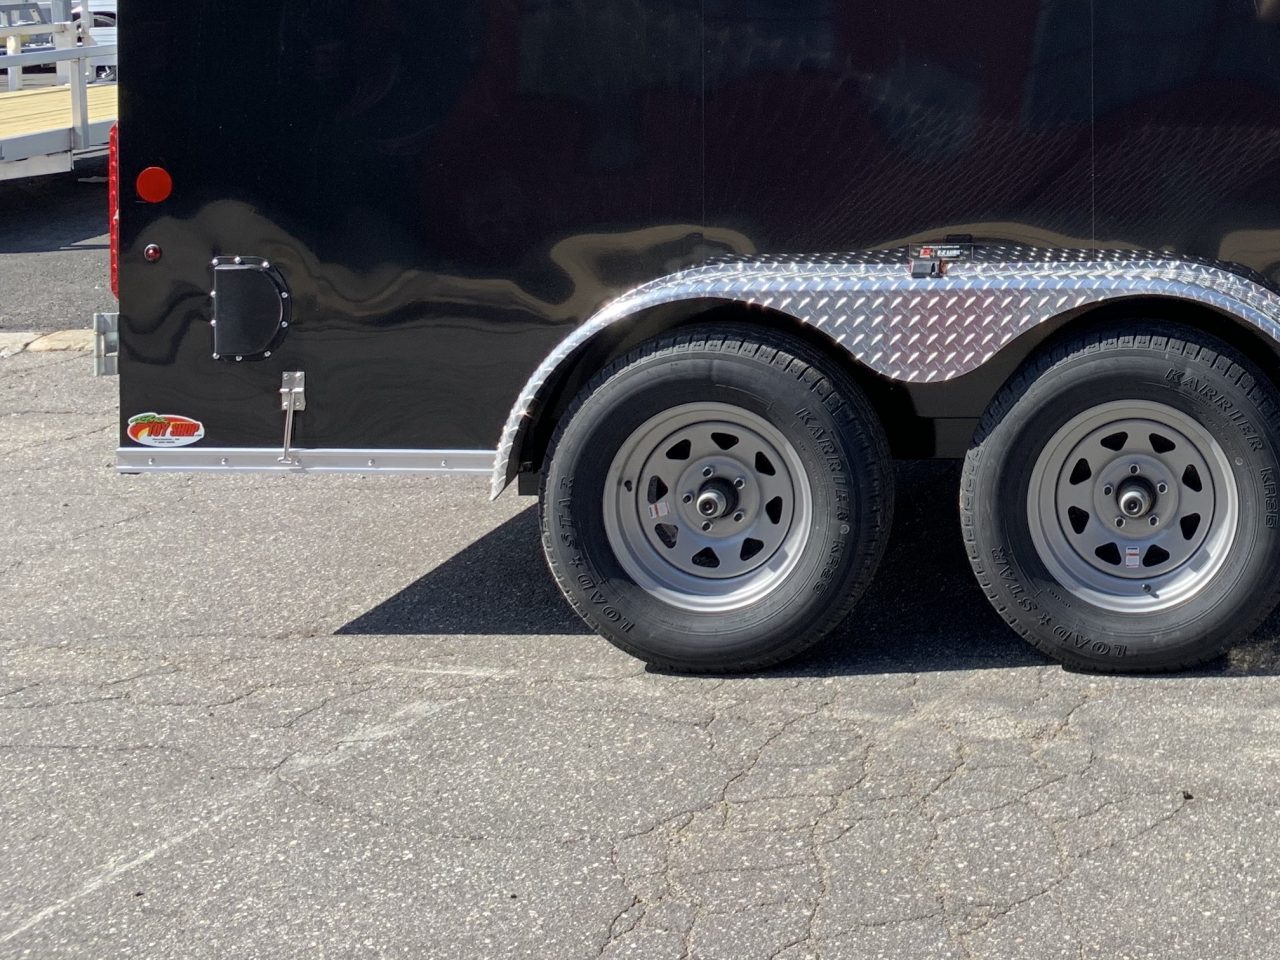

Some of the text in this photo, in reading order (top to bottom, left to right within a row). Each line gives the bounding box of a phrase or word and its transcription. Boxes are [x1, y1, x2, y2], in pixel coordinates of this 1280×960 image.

[147, 421, 201, 437] TOY SHOP
[794, 407, 850, 521] KARRIER
[1165, 368, 1263, 452] KARRIER
[559, 475, 636, 633] LOAD STAR
[991, 545, 1128, 658] LOAD STAR
